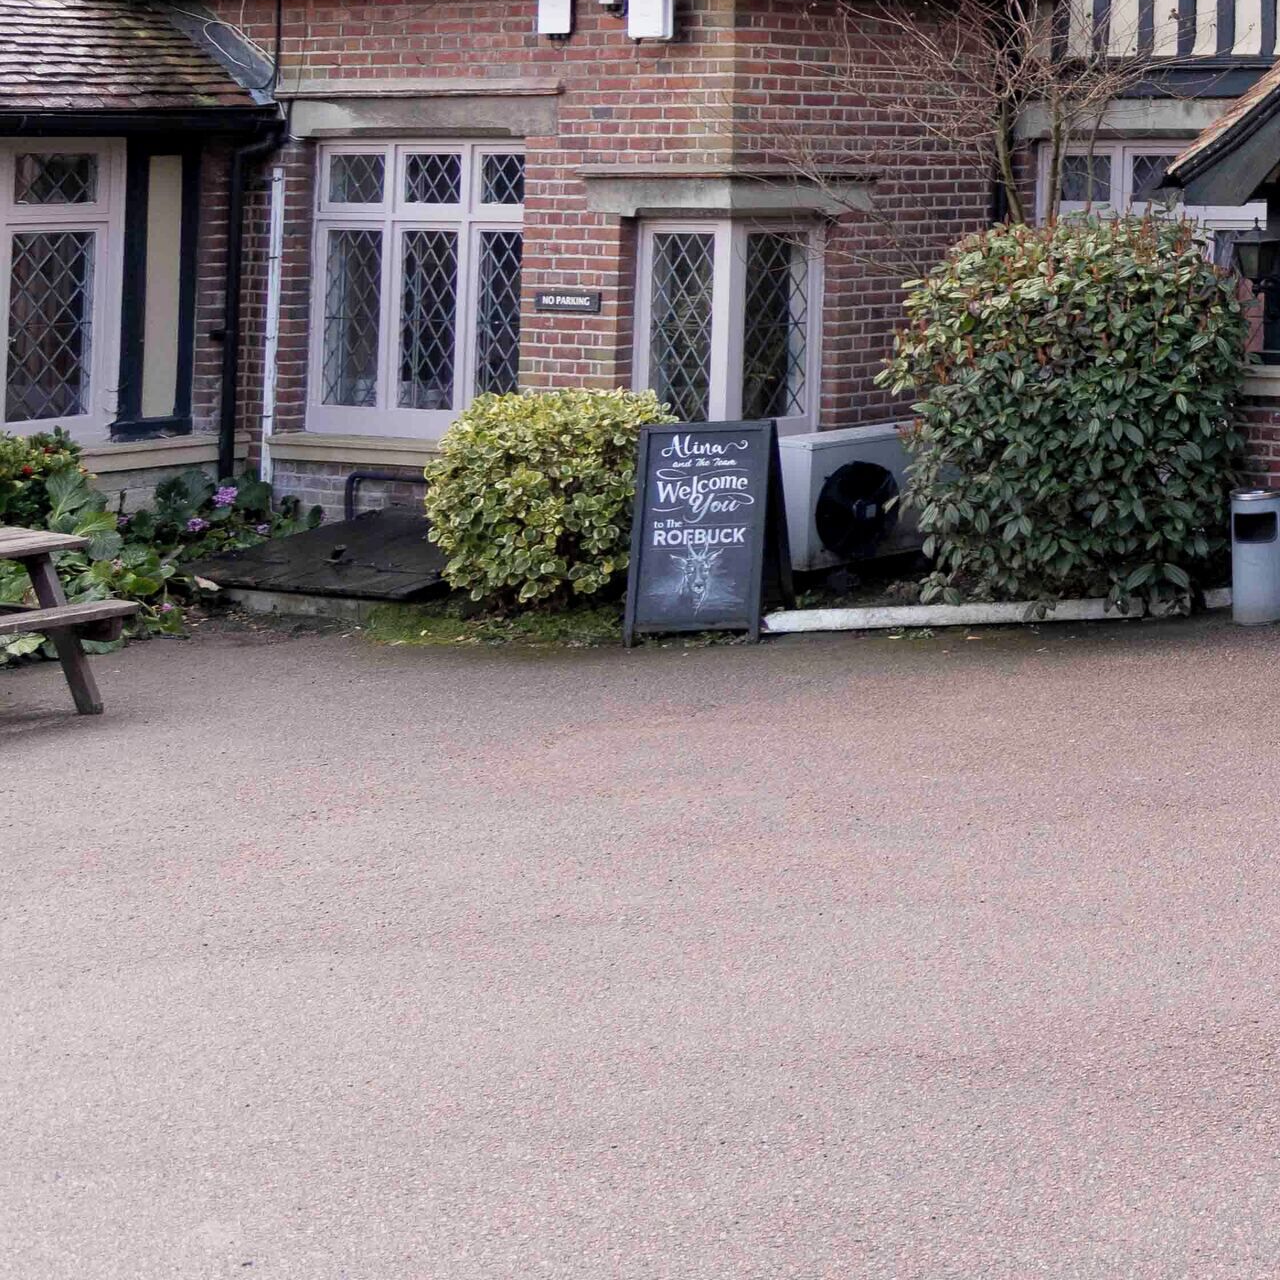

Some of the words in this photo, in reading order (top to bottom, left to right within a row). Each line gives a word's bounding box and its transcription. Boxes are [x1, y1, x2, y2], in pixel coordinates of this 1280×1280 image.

[542, 296, 555, 304] NO
[556, 296, 590, 305] PARKING
[661, 434, 748, 458] Alina
[672, 459, 693, 468] and
[656, 475, 748, 504] Welcome
[683, 493, 742, 523] You
[666, 519, 683, 528] The
[653, 527, 747, 546] ROEBUCK
